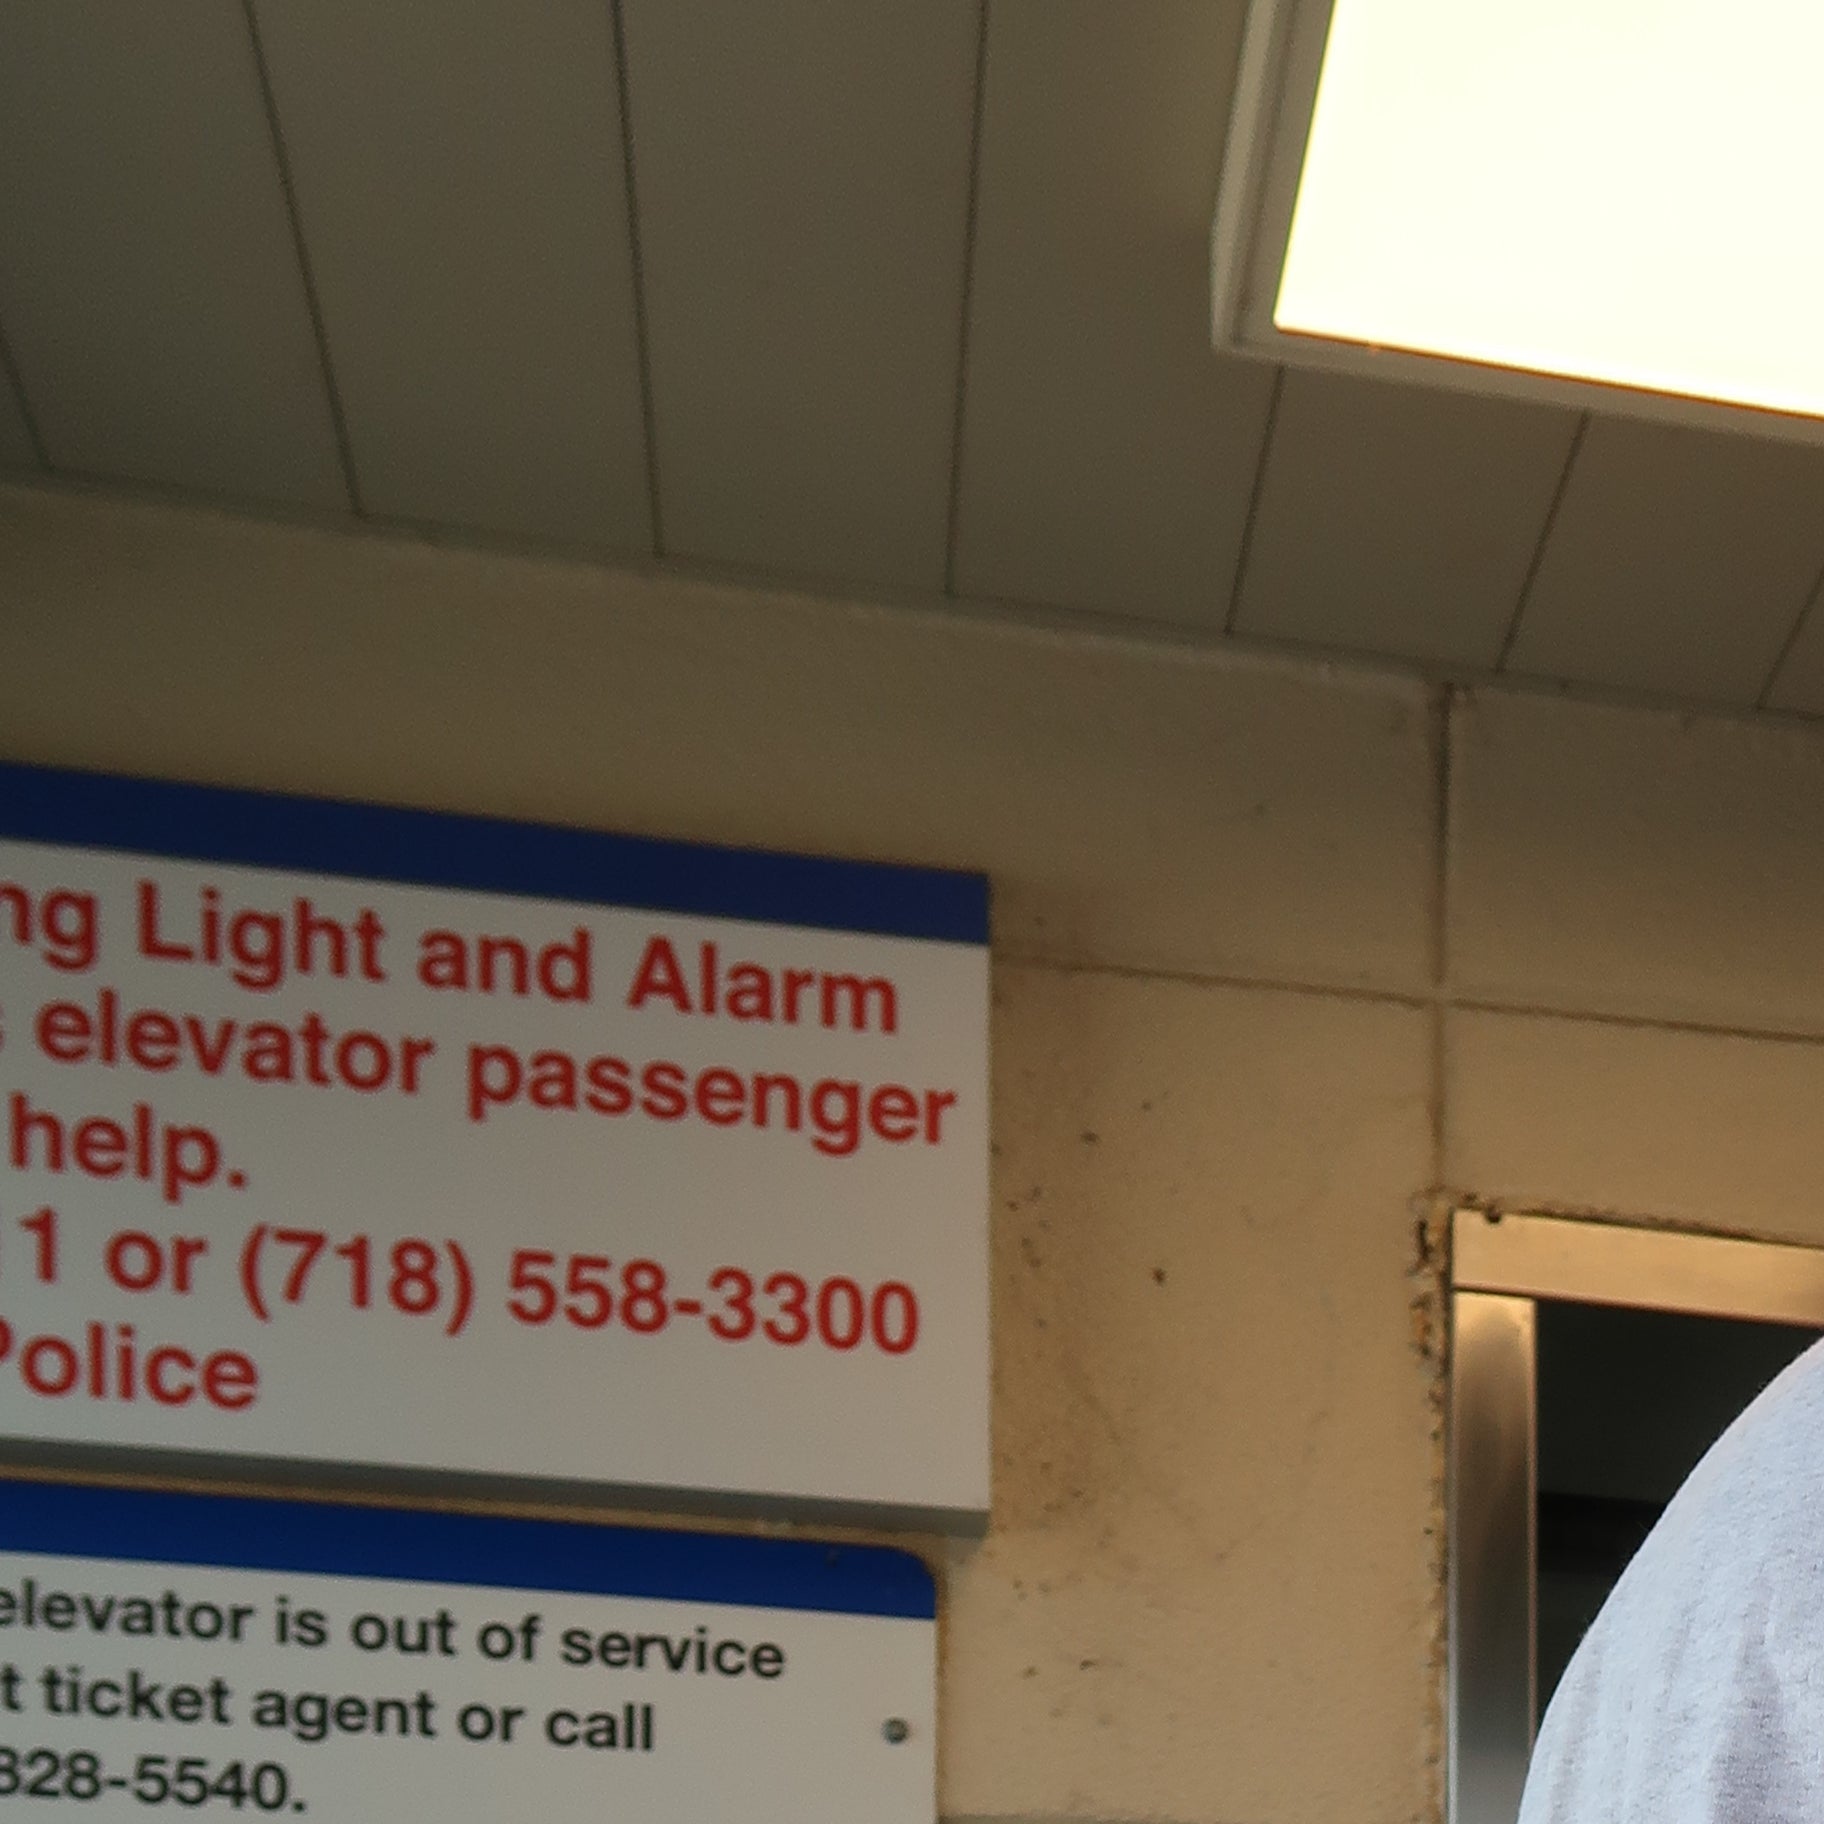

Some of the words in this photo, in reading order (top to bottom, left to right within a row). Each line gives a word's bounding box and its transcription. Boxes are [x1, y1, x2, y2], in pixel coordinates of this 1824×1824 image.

[138, 880, 386, 992] Light
[418, 926, 593, 1001] and
[628, 935, 900, 1035] Alarm
[36, 989, 435, 1093] elevator
[469, 1041, 958, 1157] passenger
[8, 1094, 248, 1201] help.
[18, 1209, 58, 1282] 1
[106, 1226, 204, 1294] or
[239, 1224, 475, 1336] (718)
[507, 1248, 918, 1355] 558-3300
[0, 1314, 259, 1409] olice
[276, 1597, 327, 1647] is
[353, 1608, 455, 1657] out
[478, 1614, 541, 1663] of
[561, 1626, 784, 1680] service
[40, 1667, 232, 1726] ticket
[253, 1689, 436, 1743] agent
[459, 1699, 524, 1742] or
[545, 1703, 654, 1752] call
